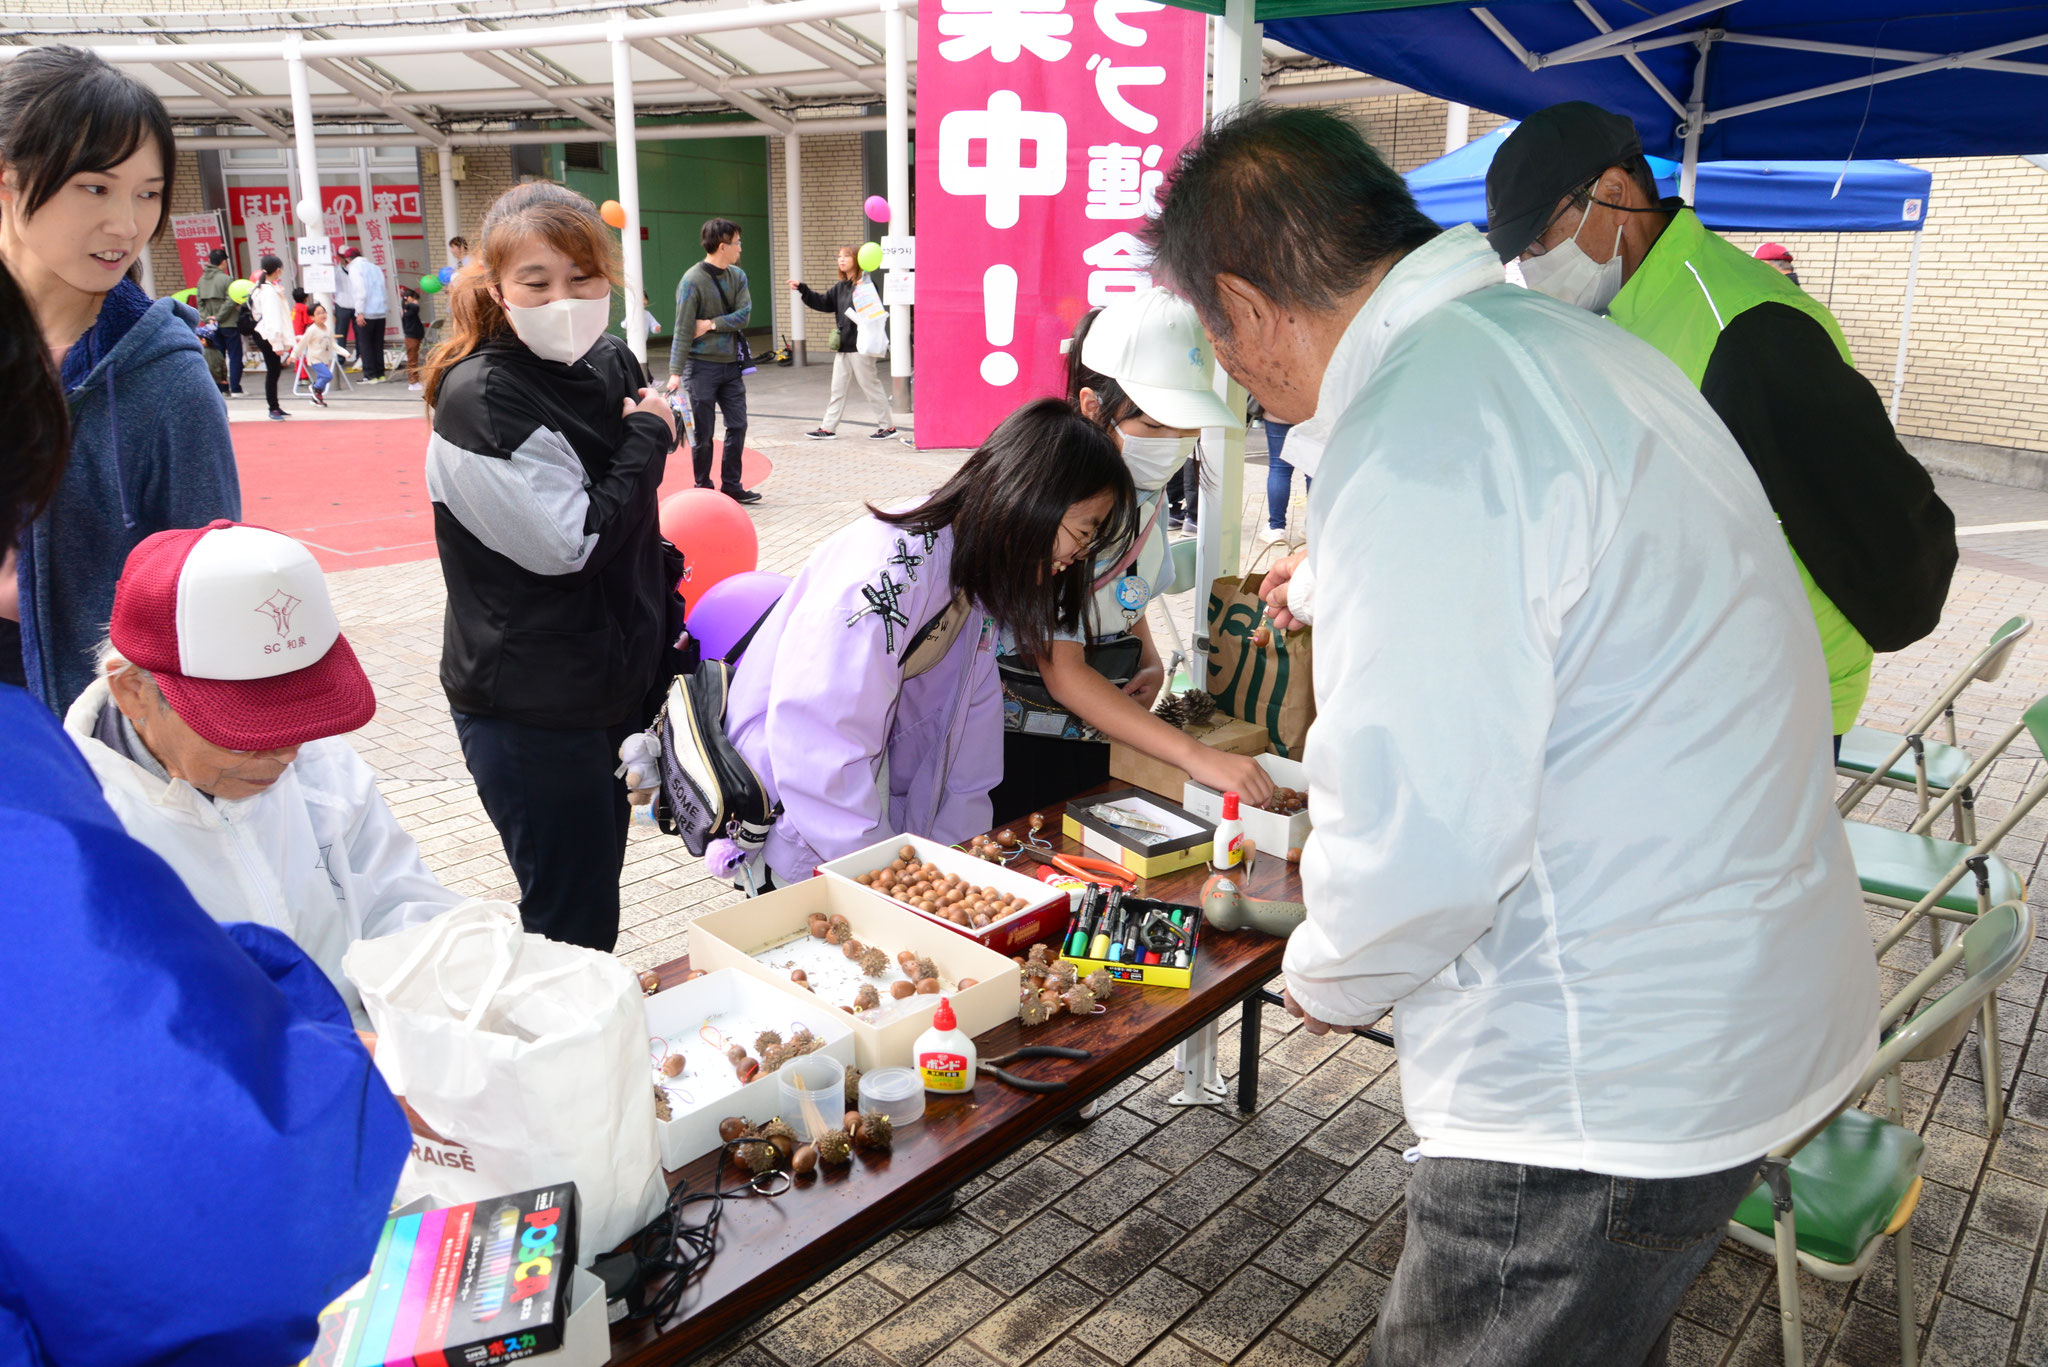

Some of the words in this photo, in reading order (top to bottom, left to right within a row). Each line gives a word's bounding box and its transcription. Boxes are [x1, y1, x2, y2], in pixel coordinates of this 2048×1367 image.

[240, 191, 421, 218] ほけの窓口
[264, 643, 281, 655] SC
[287, 636, 307, 650] 和泉
[672, 778, 700, 819] SOME
[926, 1058, 961, 1071] ボンド
[539, 1192, 549, 1210] uni
[510, 1207, 561, 1304] POSCA
[488, 1333, 536, 1356] ポスカ
